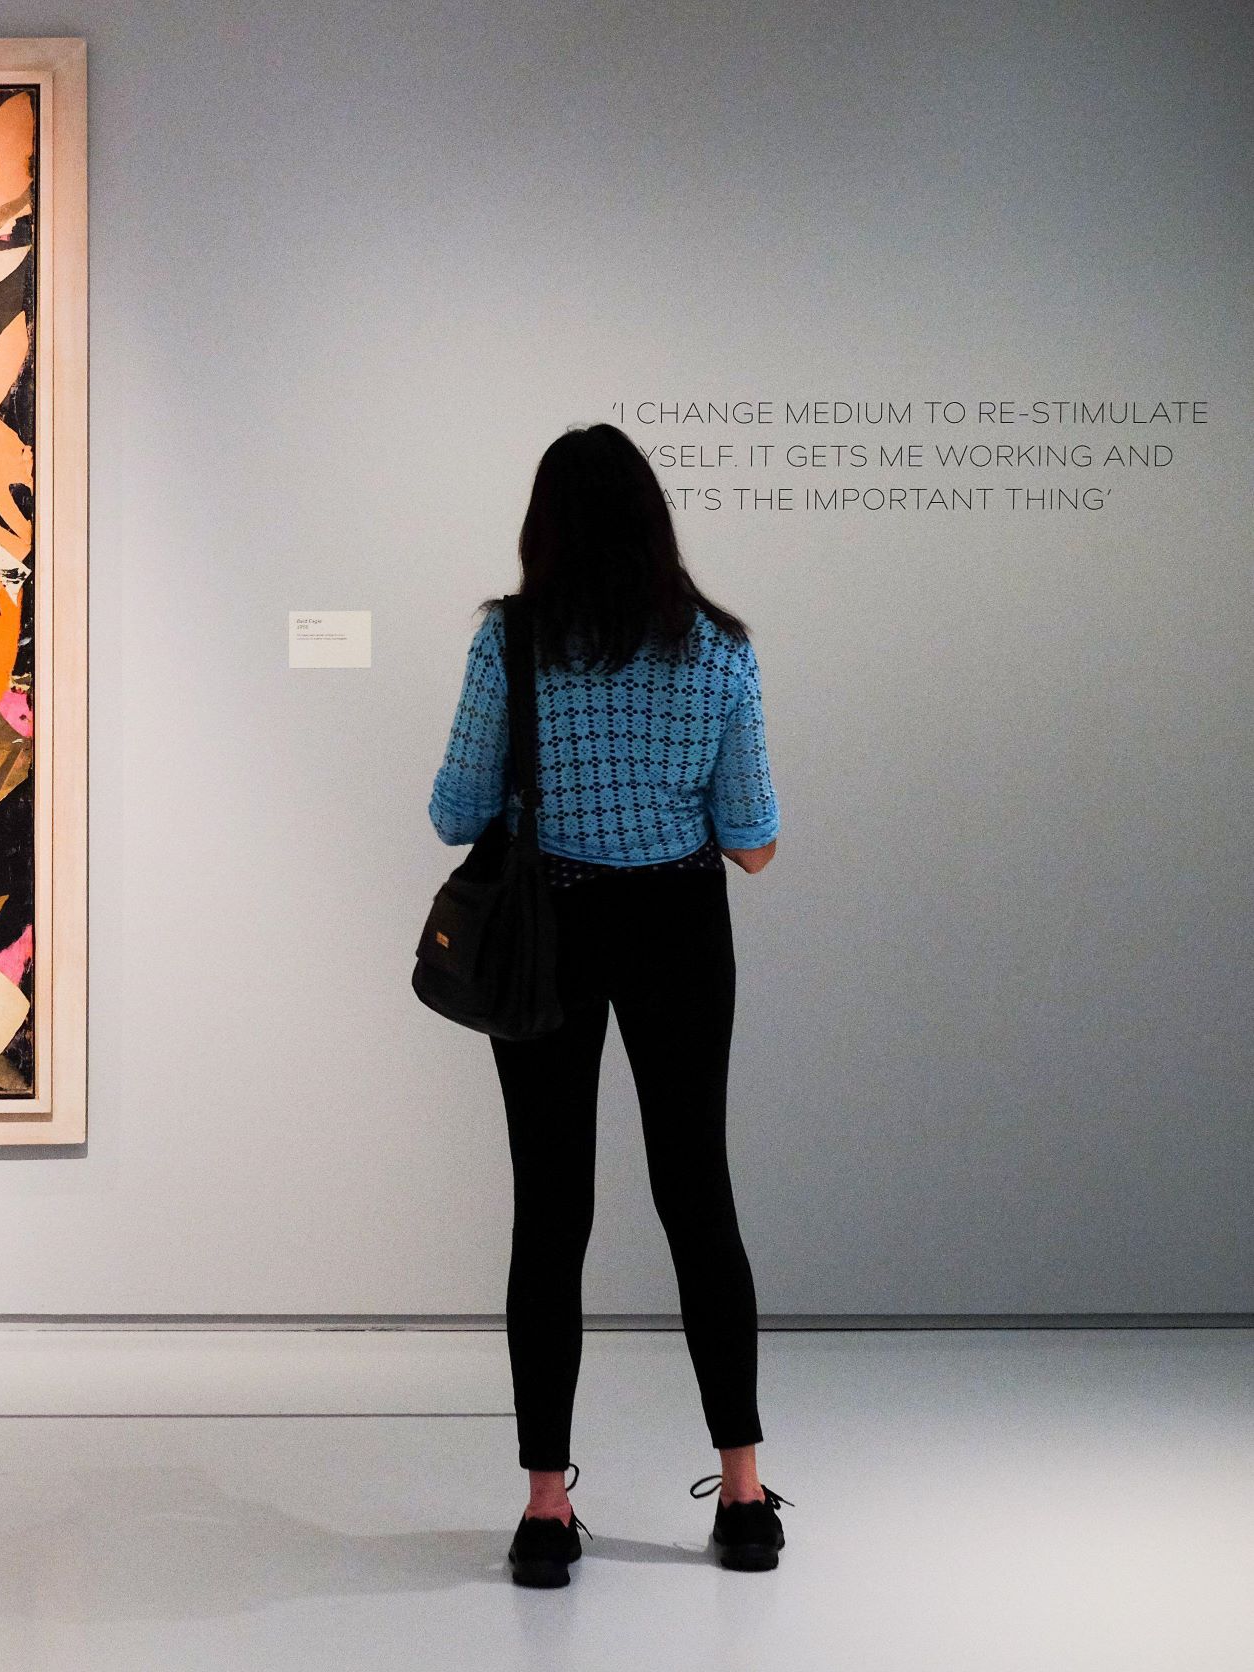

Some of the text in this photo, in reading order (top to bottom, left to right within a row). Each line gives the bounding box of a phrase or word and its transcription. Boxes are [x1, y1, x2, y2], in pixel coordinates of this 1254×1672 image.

[636, 401, 773, 425] CHANGE
[786, 402, 911, 424] MEDIUM
[925, 401, 966, 425] TO
[979, 401, 1208, 425] RE-STIMULATE
[640, 444, 1173, 468] YSELF. IT GETS ME WORKING AND
[663, 488, 1111, 511] AT'S THE IMPORTANT THING'
